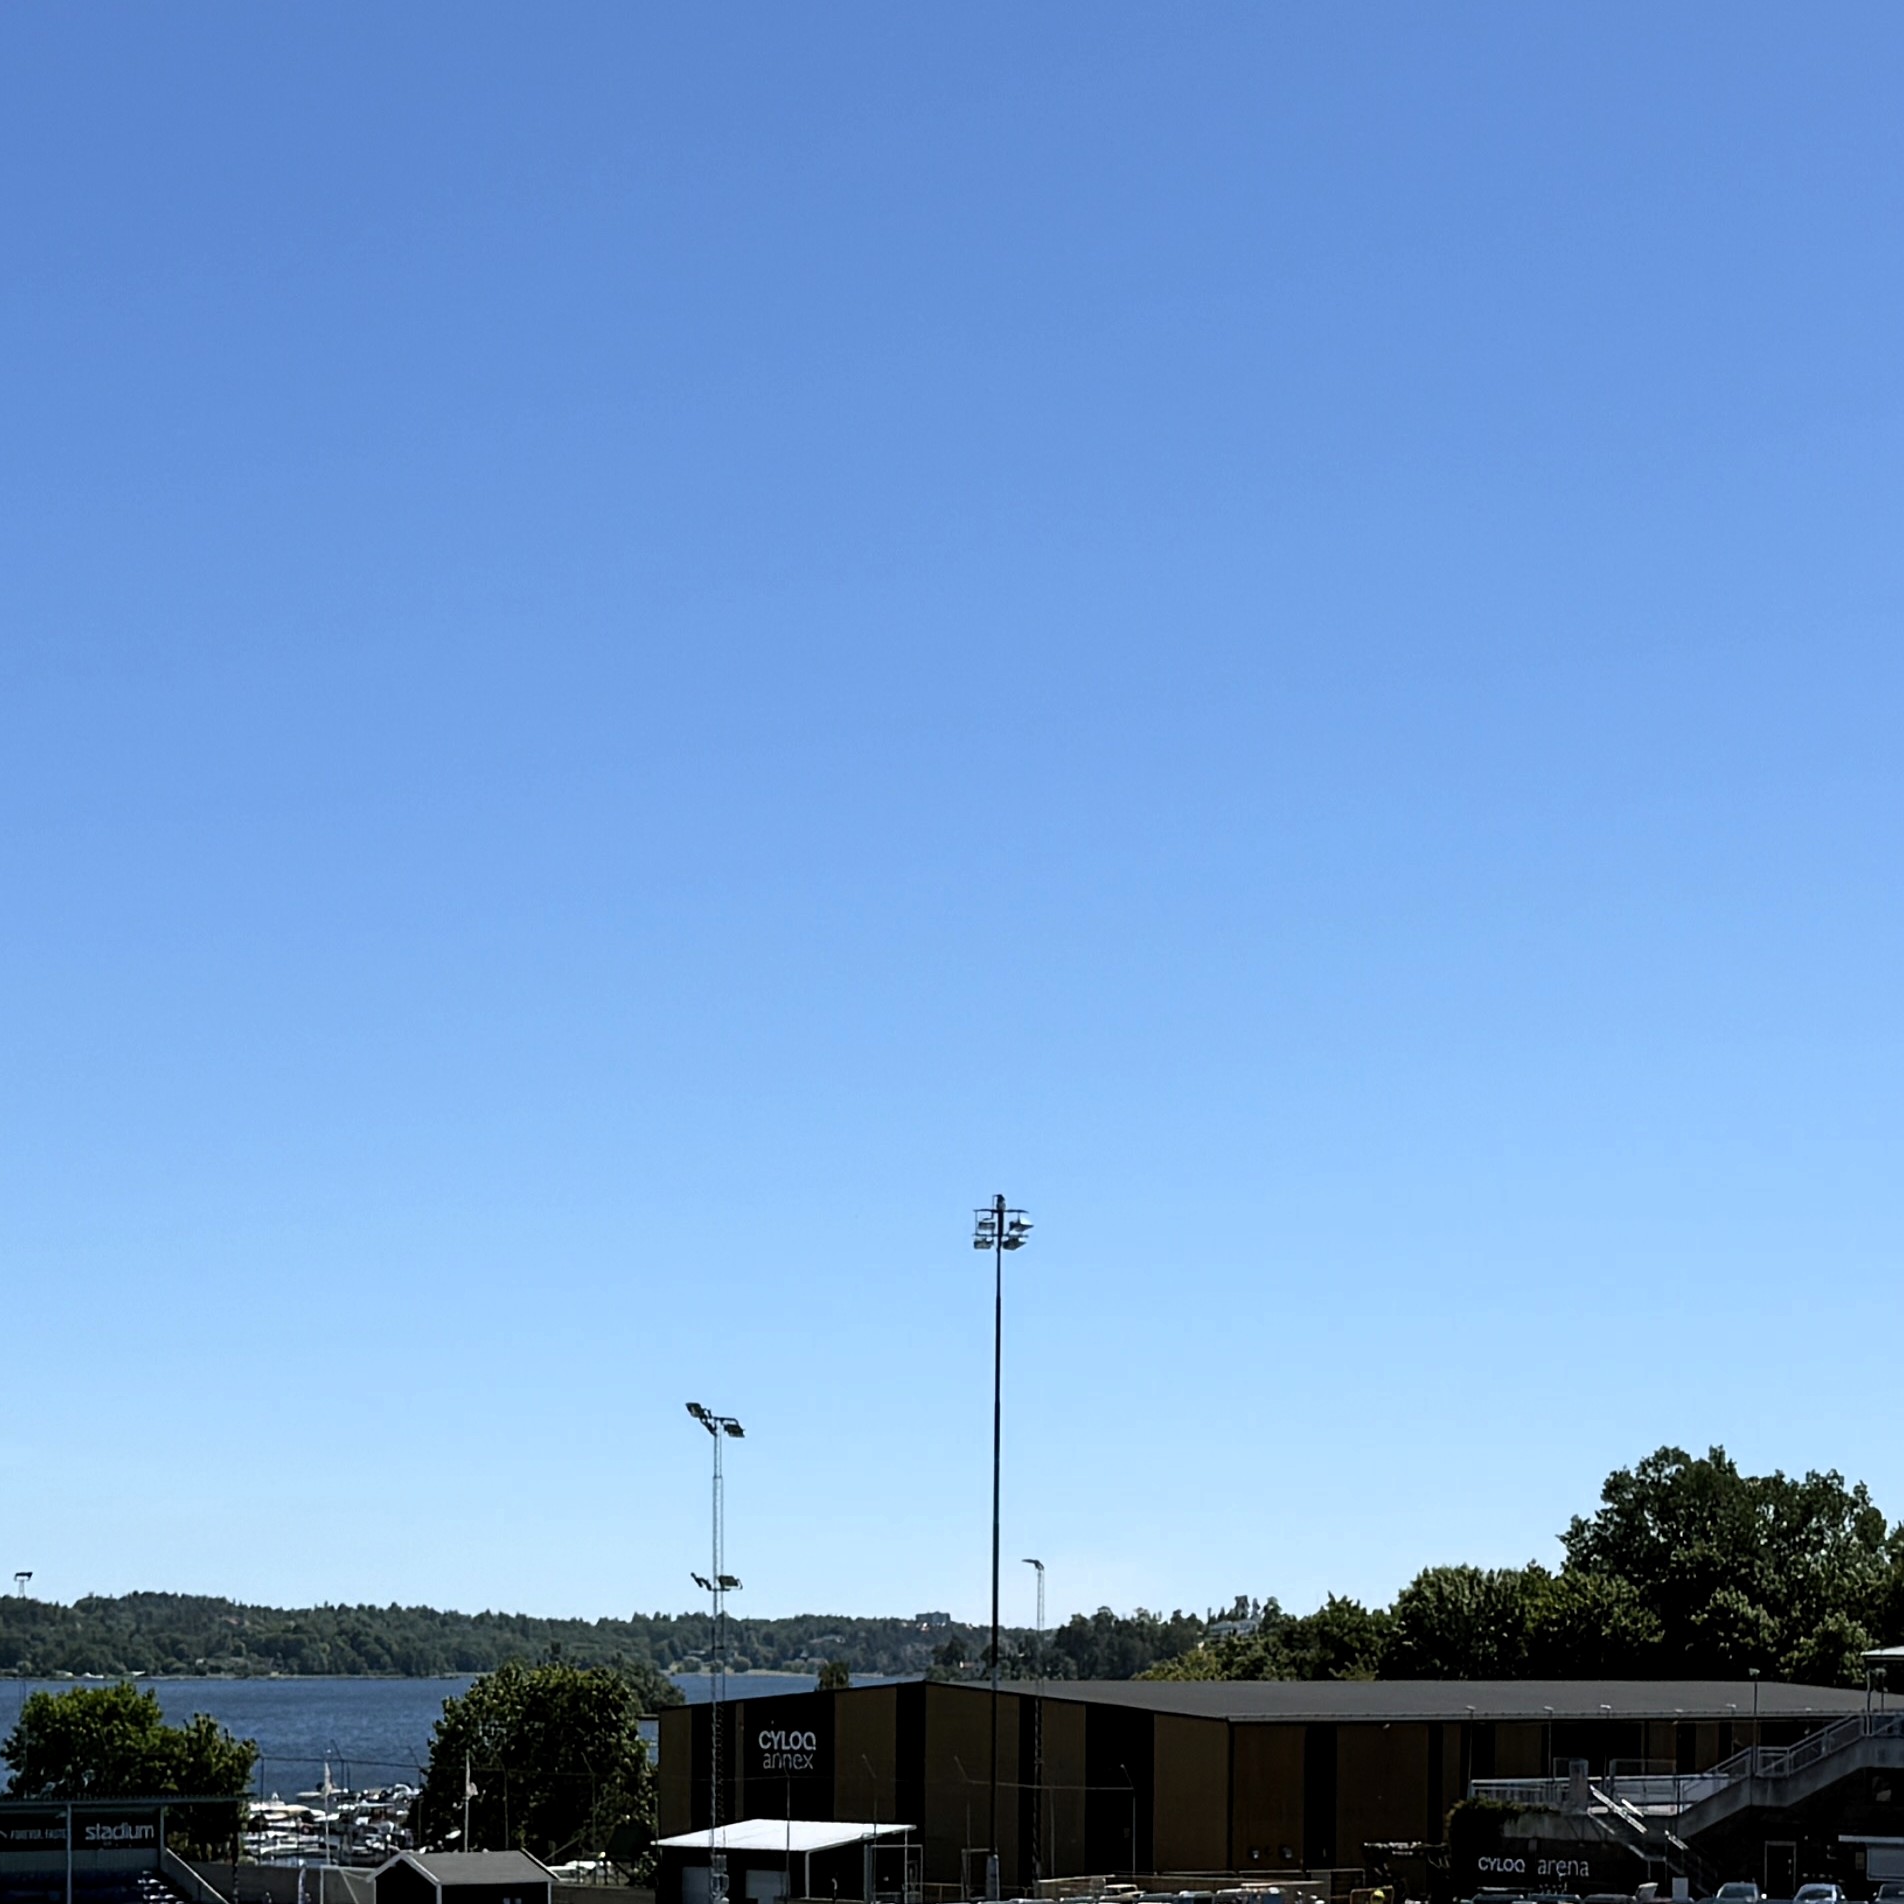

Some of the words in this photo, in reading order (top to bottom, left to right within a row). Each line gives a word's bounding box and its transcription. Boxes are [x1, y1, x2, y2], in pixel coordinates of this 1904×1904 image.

[758, 1730, 817, 1751] CYLOQ
[762, 1752, 814, 1770] annex
[85, 1822, 155, 1841] stadium
[1537, 1859, 1590, 1877] arena
